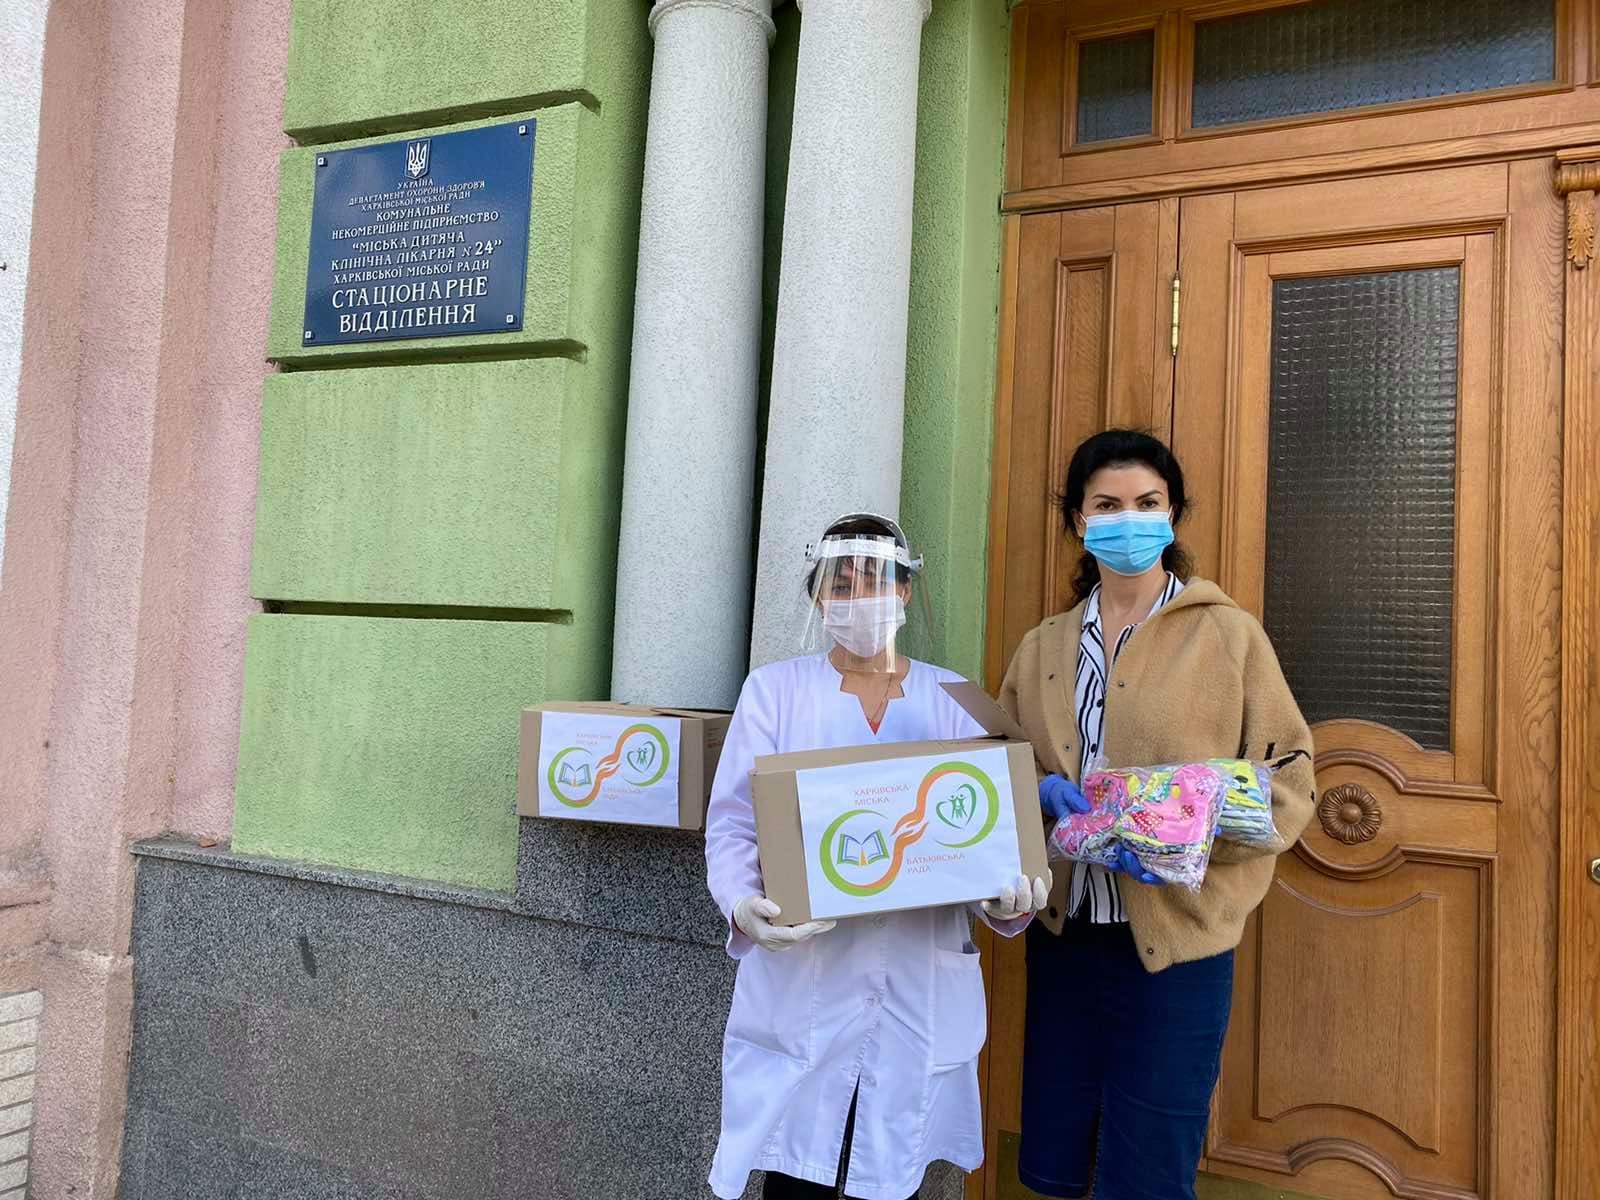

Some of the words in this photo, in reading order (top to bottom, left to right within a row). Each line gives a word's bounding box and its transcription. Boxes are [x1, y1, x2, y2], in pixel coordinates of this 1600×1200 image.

[398, 178, 433, 190] УКРАЇНА
[349, 191, 405, 206] ДЕПАРТАМЕНТ
[406, 186, 445, 197] ОХОРОНИ
[361, 198, 414, 212] ХАРКІВСЬКОЇ
[415, 192, 449, 205] МІСЬКОЇ
[449, 190, 471, 201] РАДИ
[376, 203, 451, 222] КОМУНАЛЬНЕ
[332, 219, 410, 239] НЕКОМЕРЦІЙНЕ
[413, 210, 499, 231] ПІДПРИЄМСТВО
[352, 237, 407, 253] “МІСЬКА
[411, 231, 465, 248] ДИТЯЧА
[331, 254, 392, 271] КЛІНІЧНА
[396, 246, 456, 263] ЛІКАРНЯ
[334, 266, 403, 285] ХАРКІВСЬКОЇ
[406, 261, 453, 278] МІСЬКОЇ
[457, 259, 490, 272] РАДИ
[332, 276, 488, 309] СТАЦІОНАРНЕ
[340, 303, 477, 333] ВІДДІЛЕННЯ
[854, 783, 910, 796] ХАРКІВСЬКА
[854, 796, 890, 807] МІСЬКА
[906, 853, 966, 866] БАТЬКІВСЬКА
[907, 865, 932, 874] РАДА
